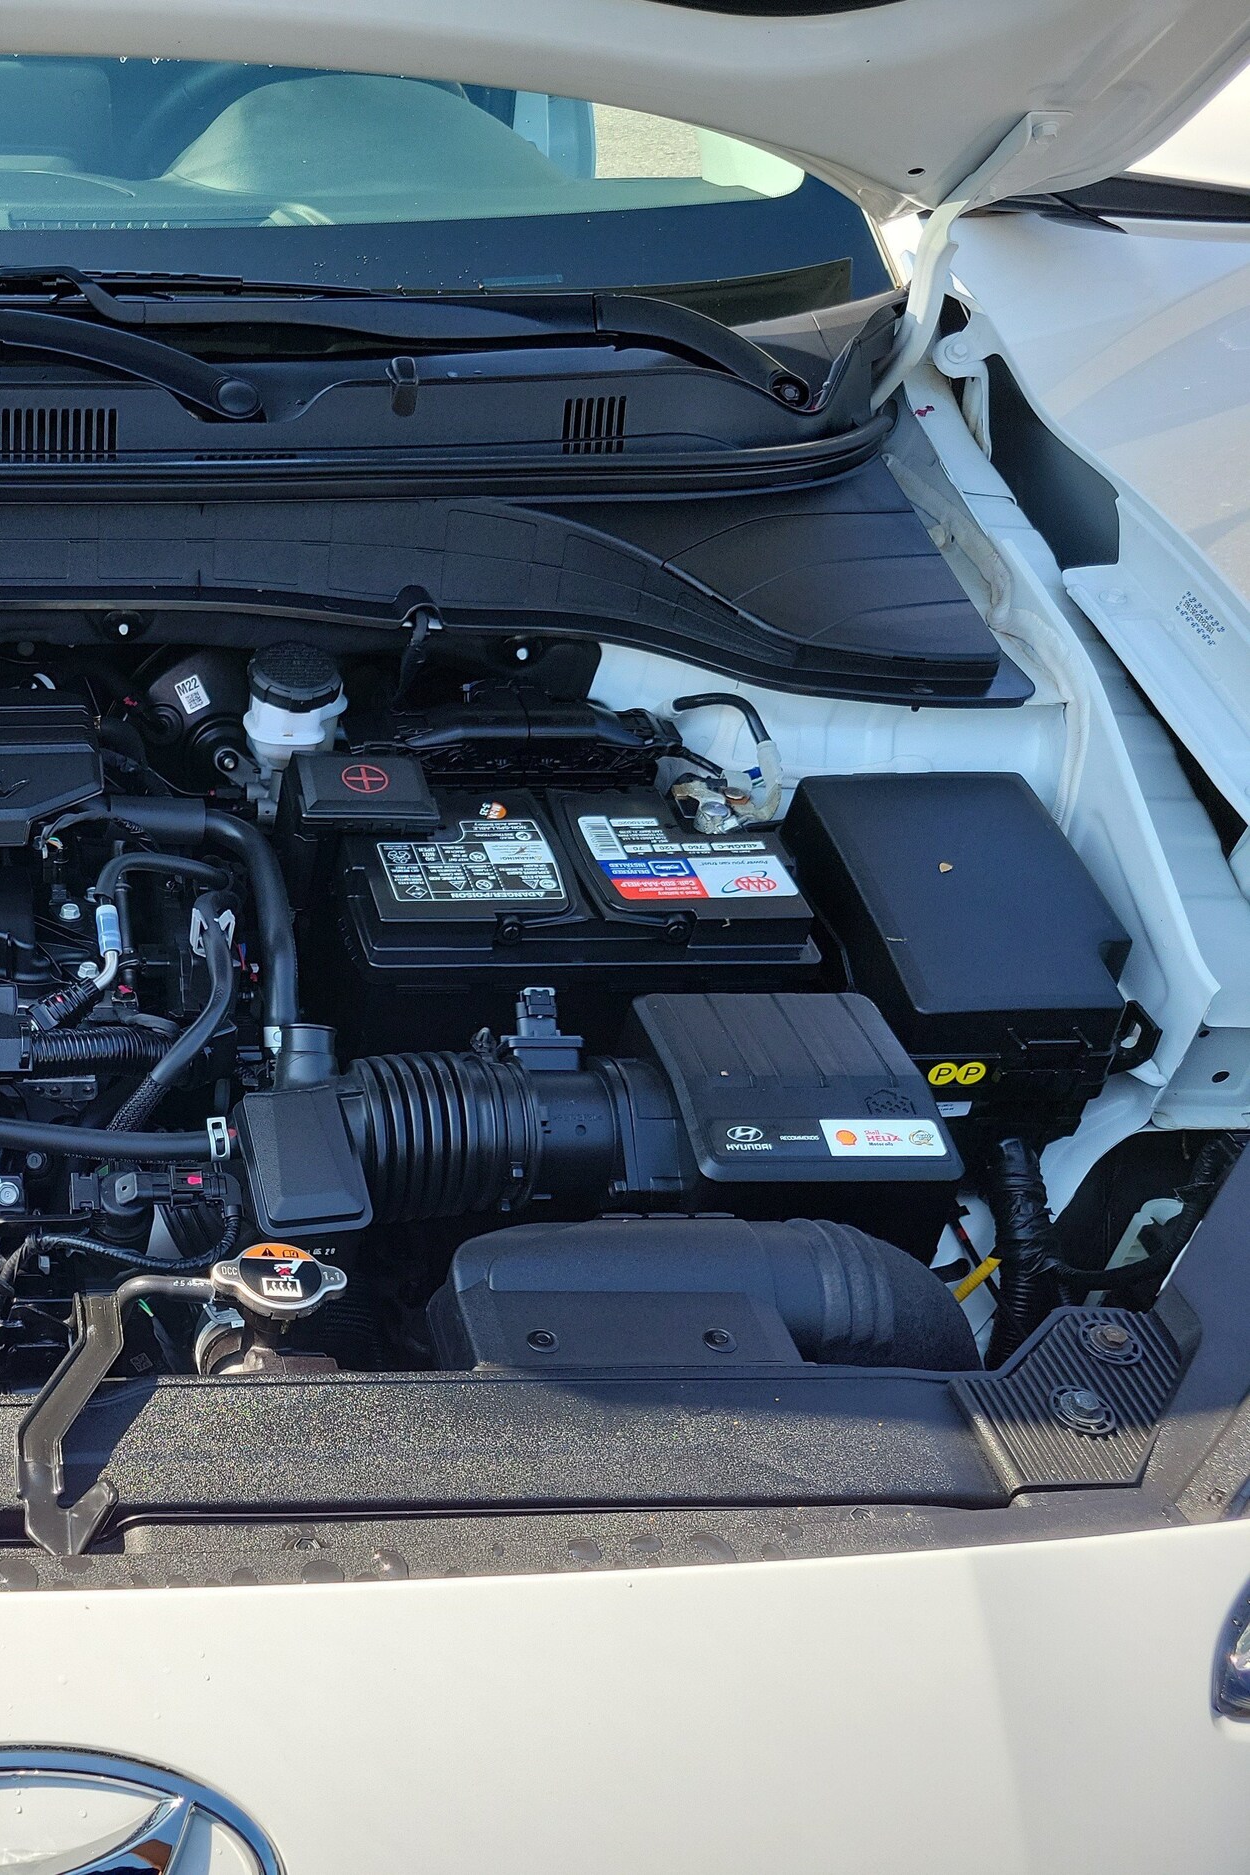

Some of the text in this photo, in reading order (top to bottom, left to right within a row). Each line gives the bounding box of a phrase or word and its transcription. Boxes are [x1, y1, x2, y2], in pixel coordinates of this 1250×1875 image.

[176, 677, 200, 696] M22
[736, 877, 776, 892] AAA
[934, 1066, 981, 1082] P P
[322, 1272, 340, 1281] 1.1
